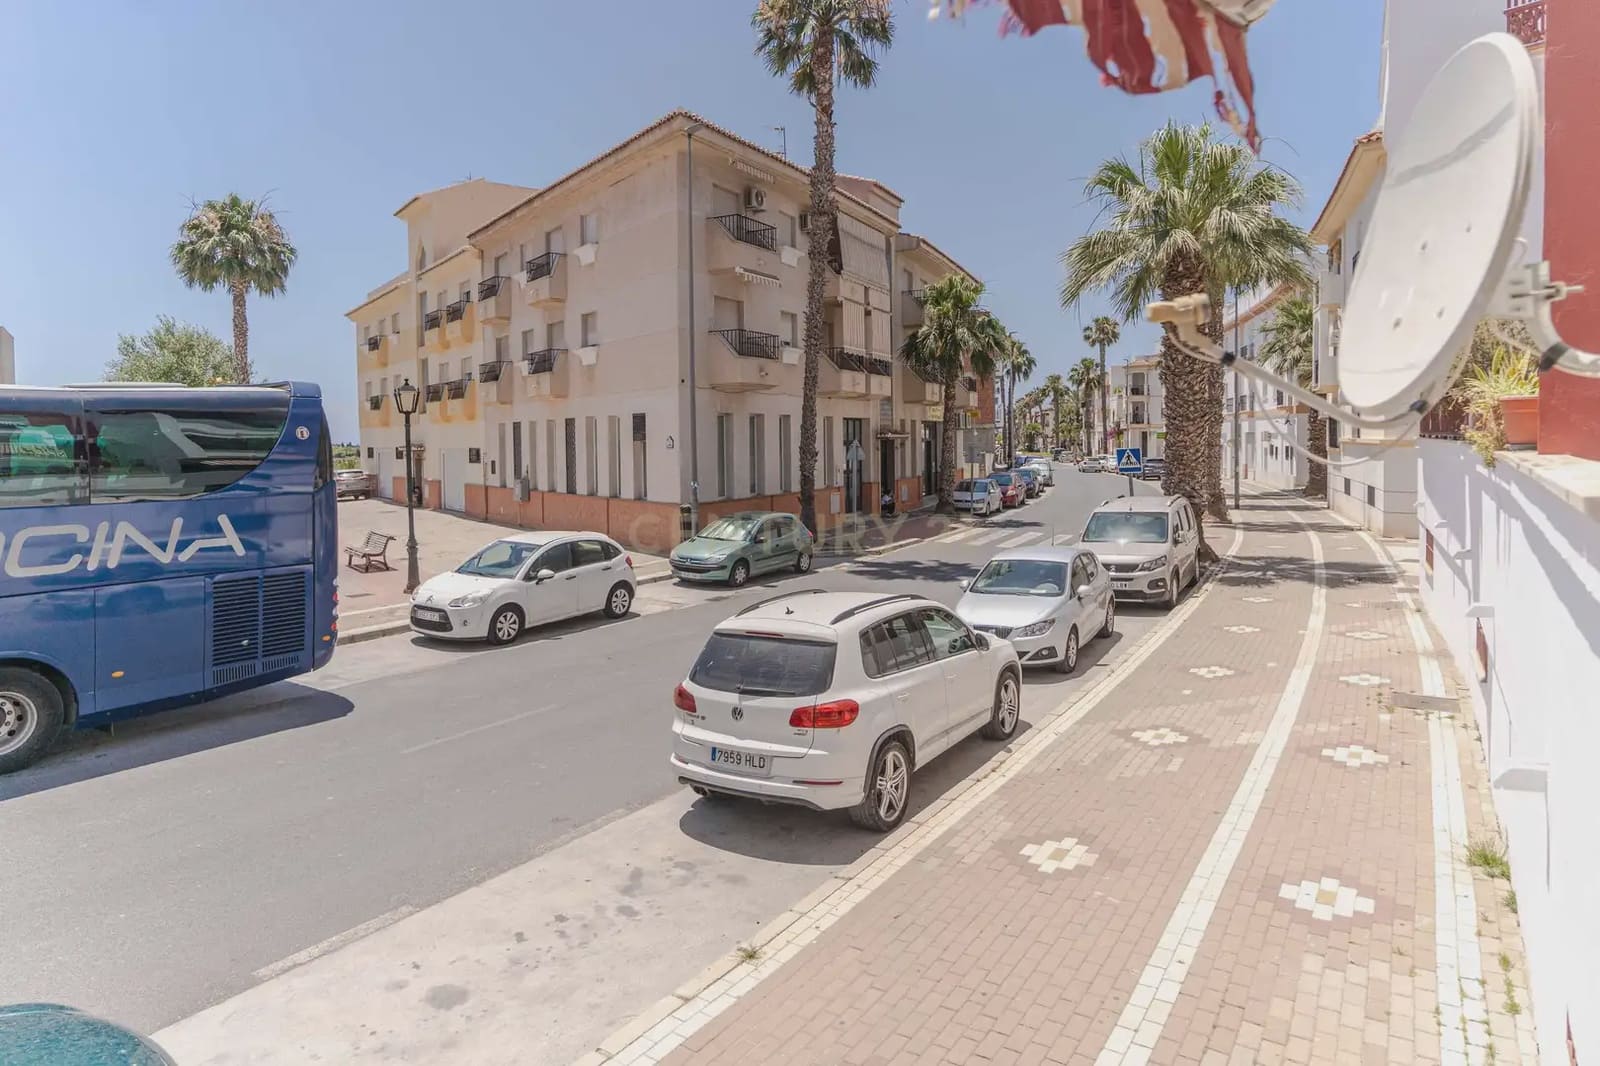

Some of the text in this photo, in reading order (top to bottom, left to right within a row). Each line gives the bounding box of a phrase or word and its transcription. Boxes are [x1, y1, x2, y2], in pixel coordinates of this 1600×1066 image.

[0, 514, 246, 578] CINA
[717, 750, 766, 769] 7959 HLD
